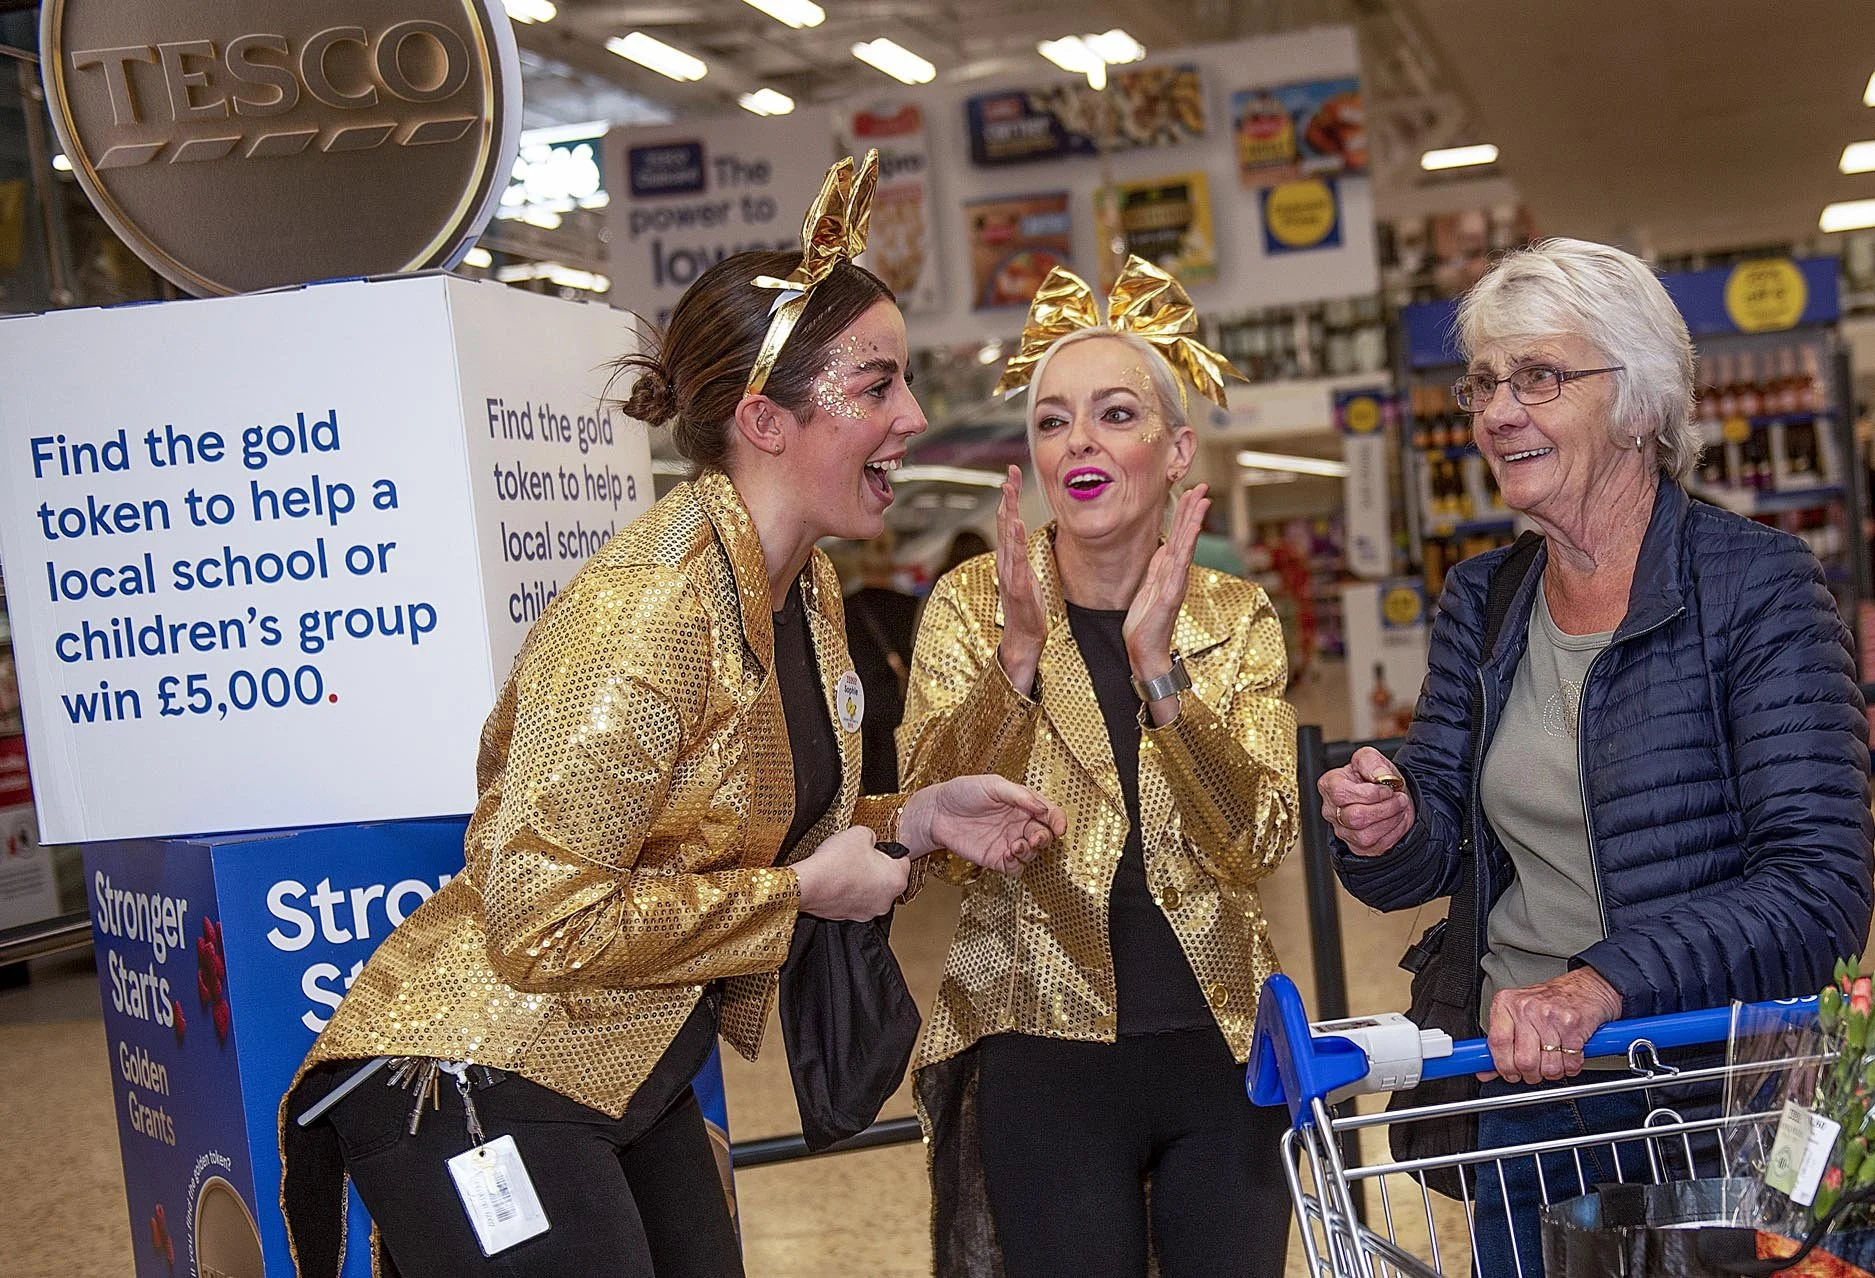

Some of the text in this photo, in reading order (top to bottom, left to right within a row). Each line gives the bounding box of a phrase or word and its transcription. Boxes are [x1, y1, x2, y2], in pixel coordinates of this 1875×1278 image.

[72, 19, 470, 126] TESCO
[714, 156, 772, 187] The
[629, 195, 777, 239] power to
[30, 409, 340, 478] Find the gold
[486, 398, 614, 454] Find the gold
[37, 475, 398, 541] token to help a
[494, 461, 637, 511] token to help a
[501, 521, 552, 562] local
[47, 538, 396, 602] local school or
[56, 603, 438, 662] children’s group
[61, 665, 338, 724] win £5,000.
[95, 869, 187, 964] Stronger
[108, 949, 175, 1028] Starts
[119, 1041, 170, 1097] Golden
[128, 1091, 176, 1146] Grants
[194, 1154, 210, 1184] golden
[208, 1149, 232, 1172] token?
[187, 1177, 196, 1201] the
[187, 1232, 196, 1264] you
